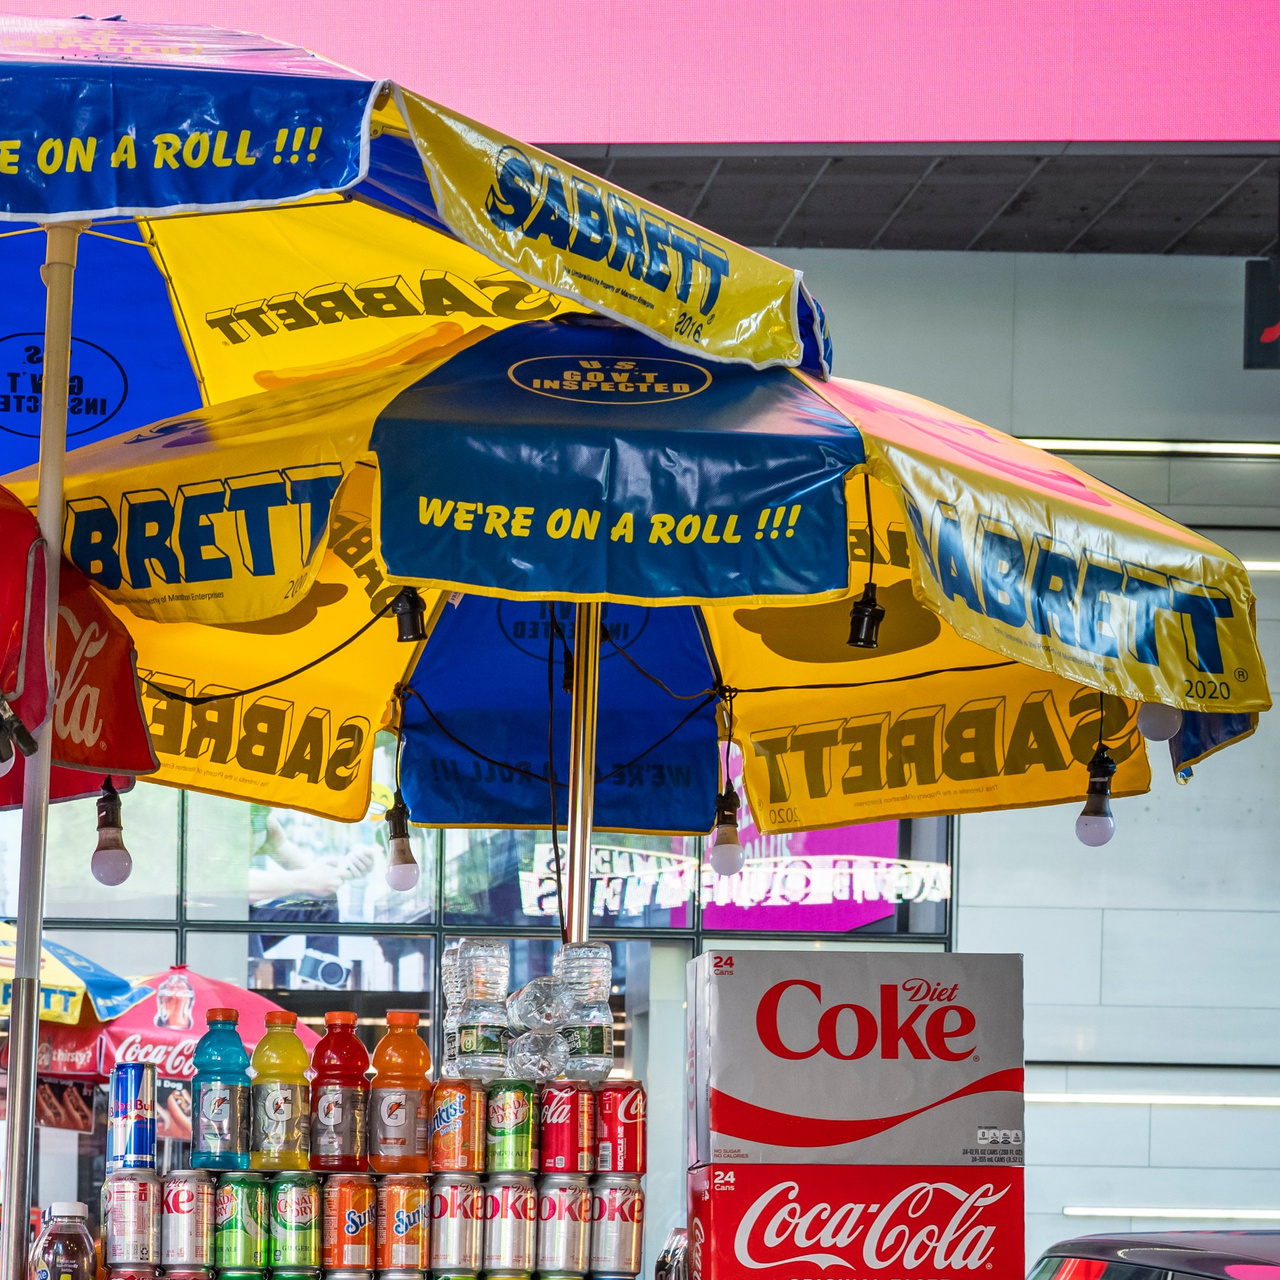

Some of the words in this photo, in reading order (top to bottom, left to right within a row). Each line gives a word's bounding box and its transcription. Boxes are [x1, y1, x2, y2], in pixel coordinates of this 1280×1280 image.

[36, 137, 95, 174] ON
[111, 136, 136, 170] A
[152, 131, 256, 169] ROLL
[272, 127, 322, 164] !!!
[485, 145, 729, 316] SABRETT
[674, 311, 703, 344] 2016
[533, 378, 690, 393] INSPECTED
[563, 370, 659, 384] GOV'T
[63, 462, 343, 590] BRETT
[419, 496, 531, 538] WE'RE
[546, 507, 601, 541] ON
[610, 513, 634, 543] A
[649, 514, 742, 545] ROLL
[755, 504, 801, 541] !!!
[1184, 679, 1231, 701] 2020
[713, 956, 734, 968] 24
[713, 968, 734, 976] Cans
[902, 977, 960, 1002] Diet
[755, 978, 977, 1062] Coke
[135, 1099, 156, 1112] Bull
[380, 1093, 406, 1127] G
[496, 1110, 520, 1124] DRY
[713, 1171, 736, 1184] 24
[714, 1183, 735, 1192] Cans
[733, 1181, 1012, 1271] Coca-Cola
